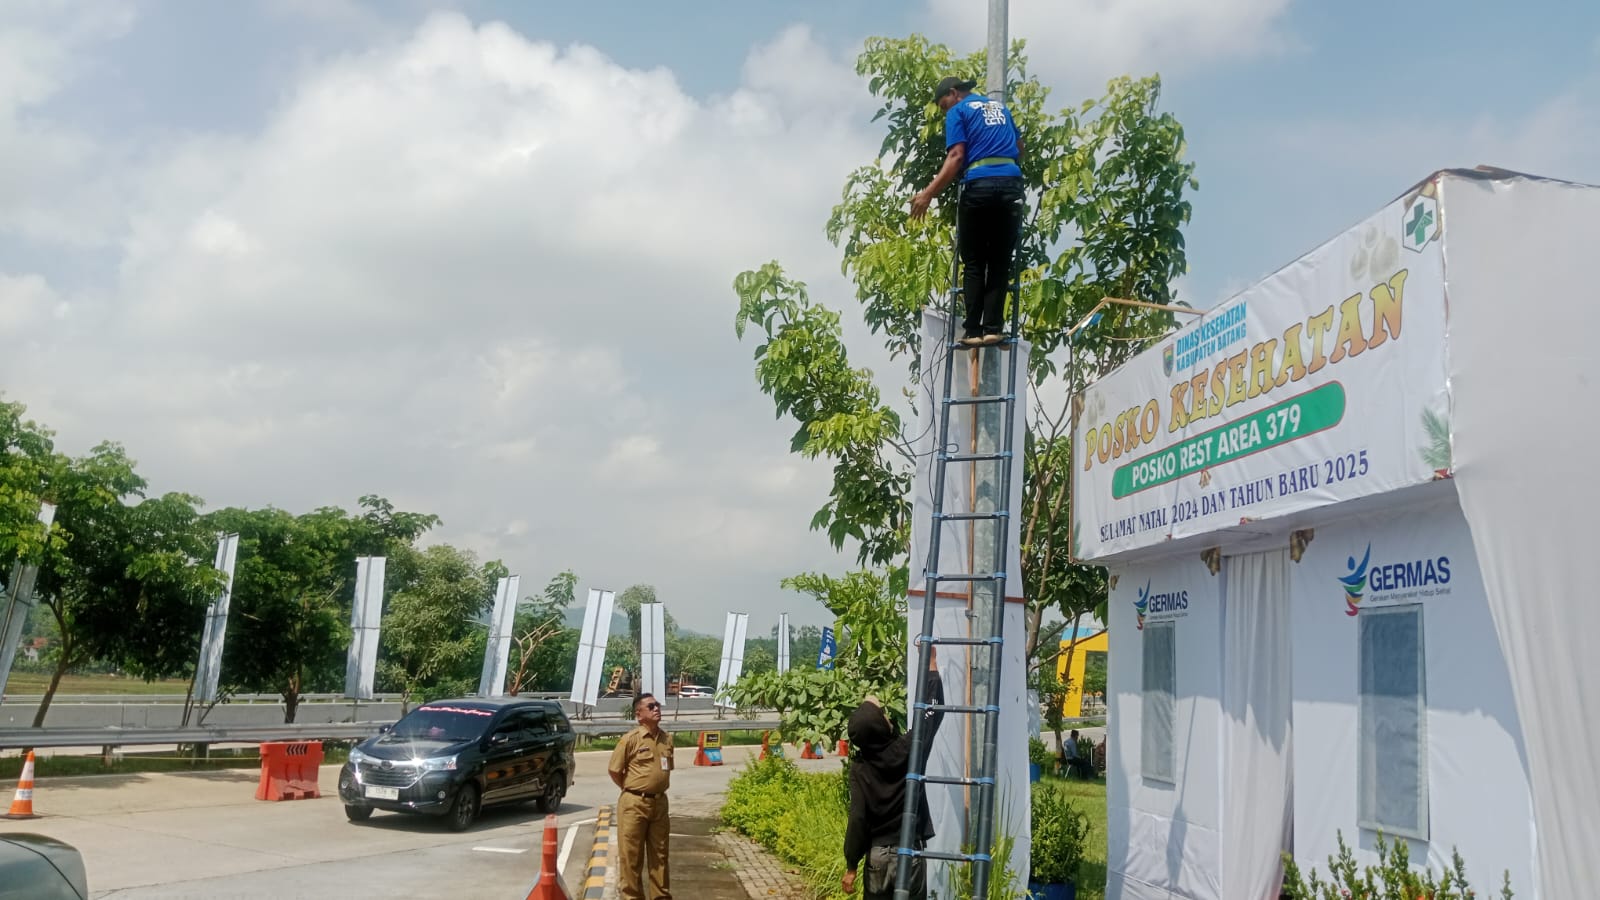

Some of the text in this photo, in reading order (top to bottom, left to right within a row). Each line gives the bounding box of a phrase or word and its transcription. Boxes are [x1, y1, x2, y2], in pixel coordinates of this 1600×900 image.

[1177, 302, 1246, 357] DINAS KESEHATAN
[1177, 322, 1246, 372] KABUPATEN BATANG
[1084, 268, 1408, 471] POSKO KESEHATAN
[1132, 404, 1301, 488] POSKO REST AREA 379
[1100, 450, 1369, 542] SELAMAT NATAL 2024 DAN TAHUN BARU 2025
[1149, 590, 1188, 613] GERMAS
[1369, 556, 1451, 592] GERMAS
